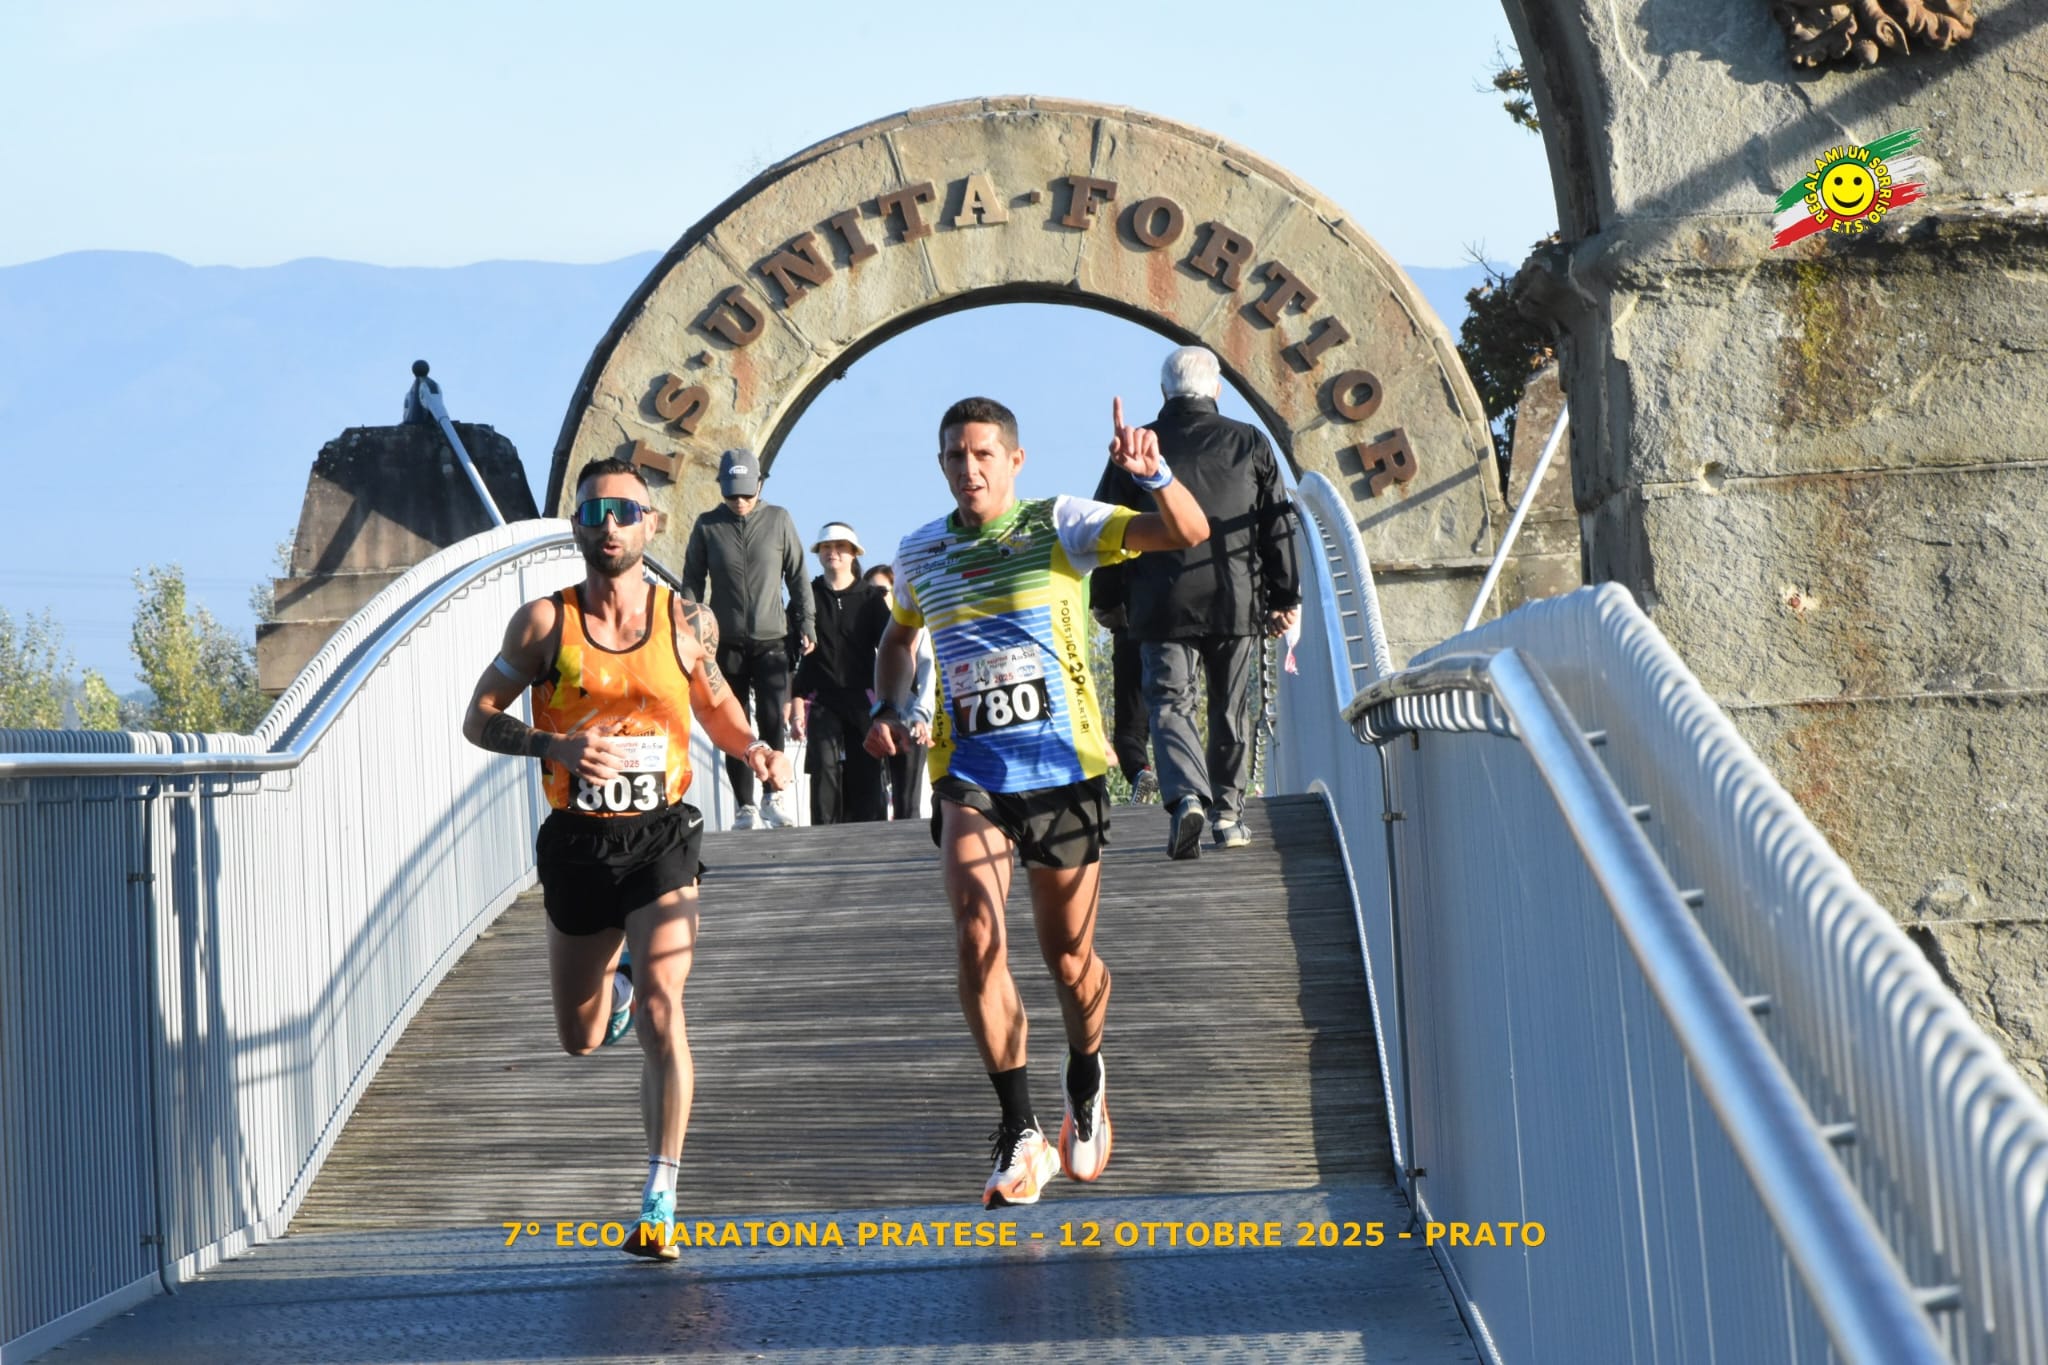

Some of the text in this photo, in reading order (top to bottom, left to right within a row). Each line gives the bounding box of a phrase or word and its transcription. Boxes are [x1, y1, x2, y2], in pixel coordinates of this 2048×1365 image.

[703, 172, 1009, 348] UNITA
[1063, 175, 1418, 498] FORTIOR
[1060, 600, 1078, 661] PODISTICA
[959, 682, 1041, 733] 780
[576, 773, 659, 812] 803
